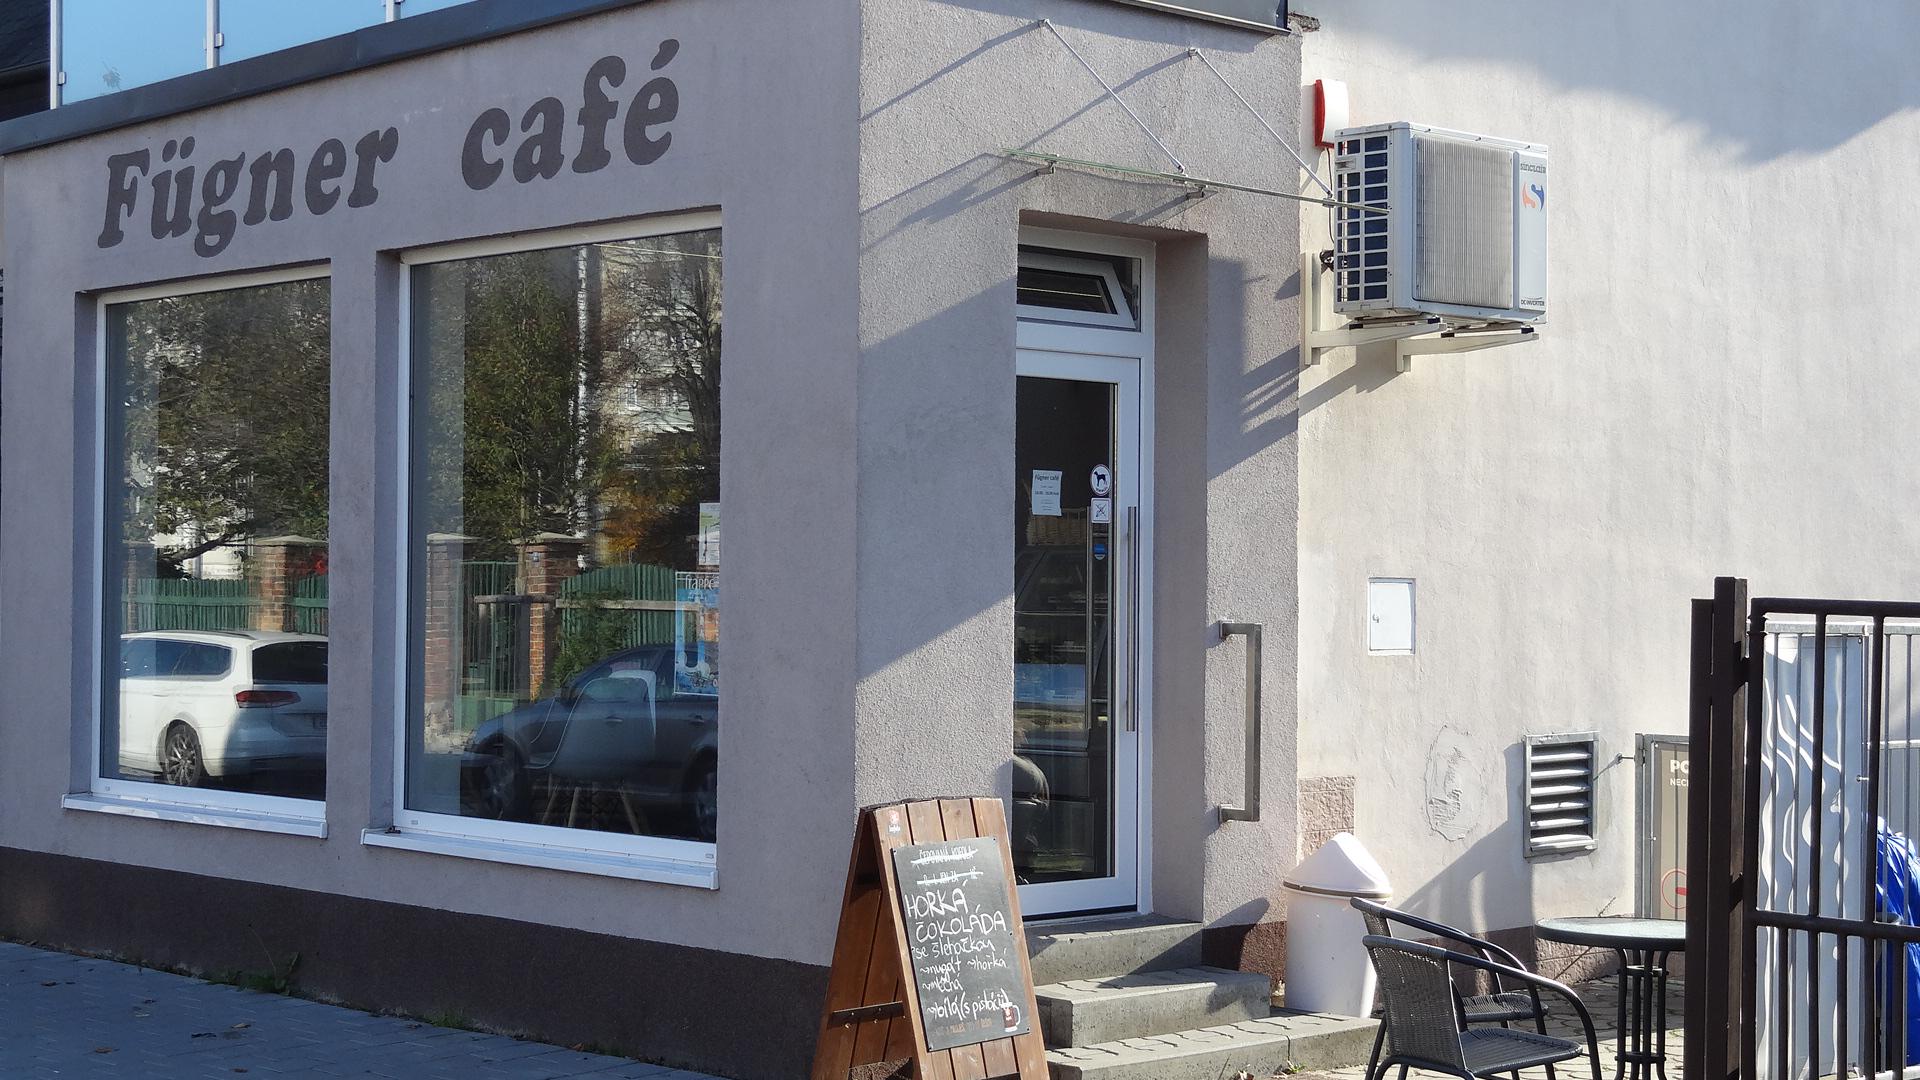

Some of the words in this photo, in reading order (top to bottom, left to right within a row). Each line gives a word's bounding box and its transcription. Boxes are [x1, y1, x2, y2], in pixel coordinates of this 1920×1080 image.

[97, 126, 399, 258] Fügner
[461, 38, 680, 190] café
[904, 879, 969, 919] HORKÁ
[916, 904, 1007, 942] ČOKOLÁDA
[914, 946, 929, 959] se
